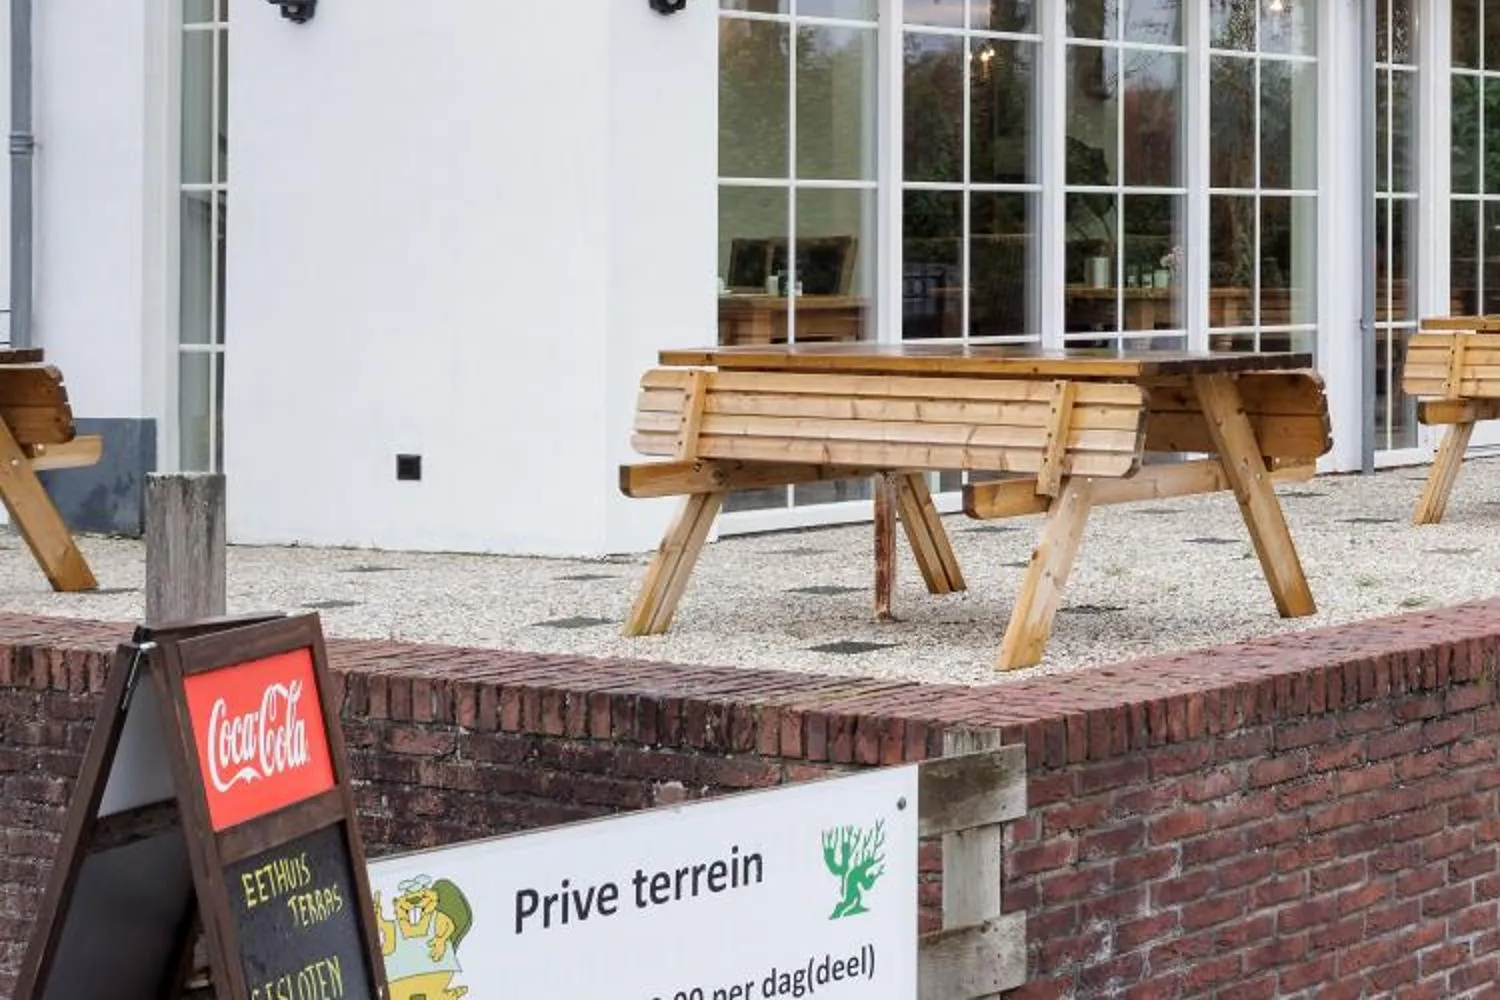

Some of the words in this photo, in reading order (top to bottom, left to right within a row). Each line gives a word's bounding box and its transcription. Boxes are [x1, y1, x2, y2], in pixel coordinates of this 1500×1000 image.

[241, 853, 311, 908] EETHUIS
[287, 883, 343, 927] TERRAS
[515, 879, 619, 934] Prive
[632, 845, 763, 909] terrein
[762, 944, 876, 998] dag(deel)
